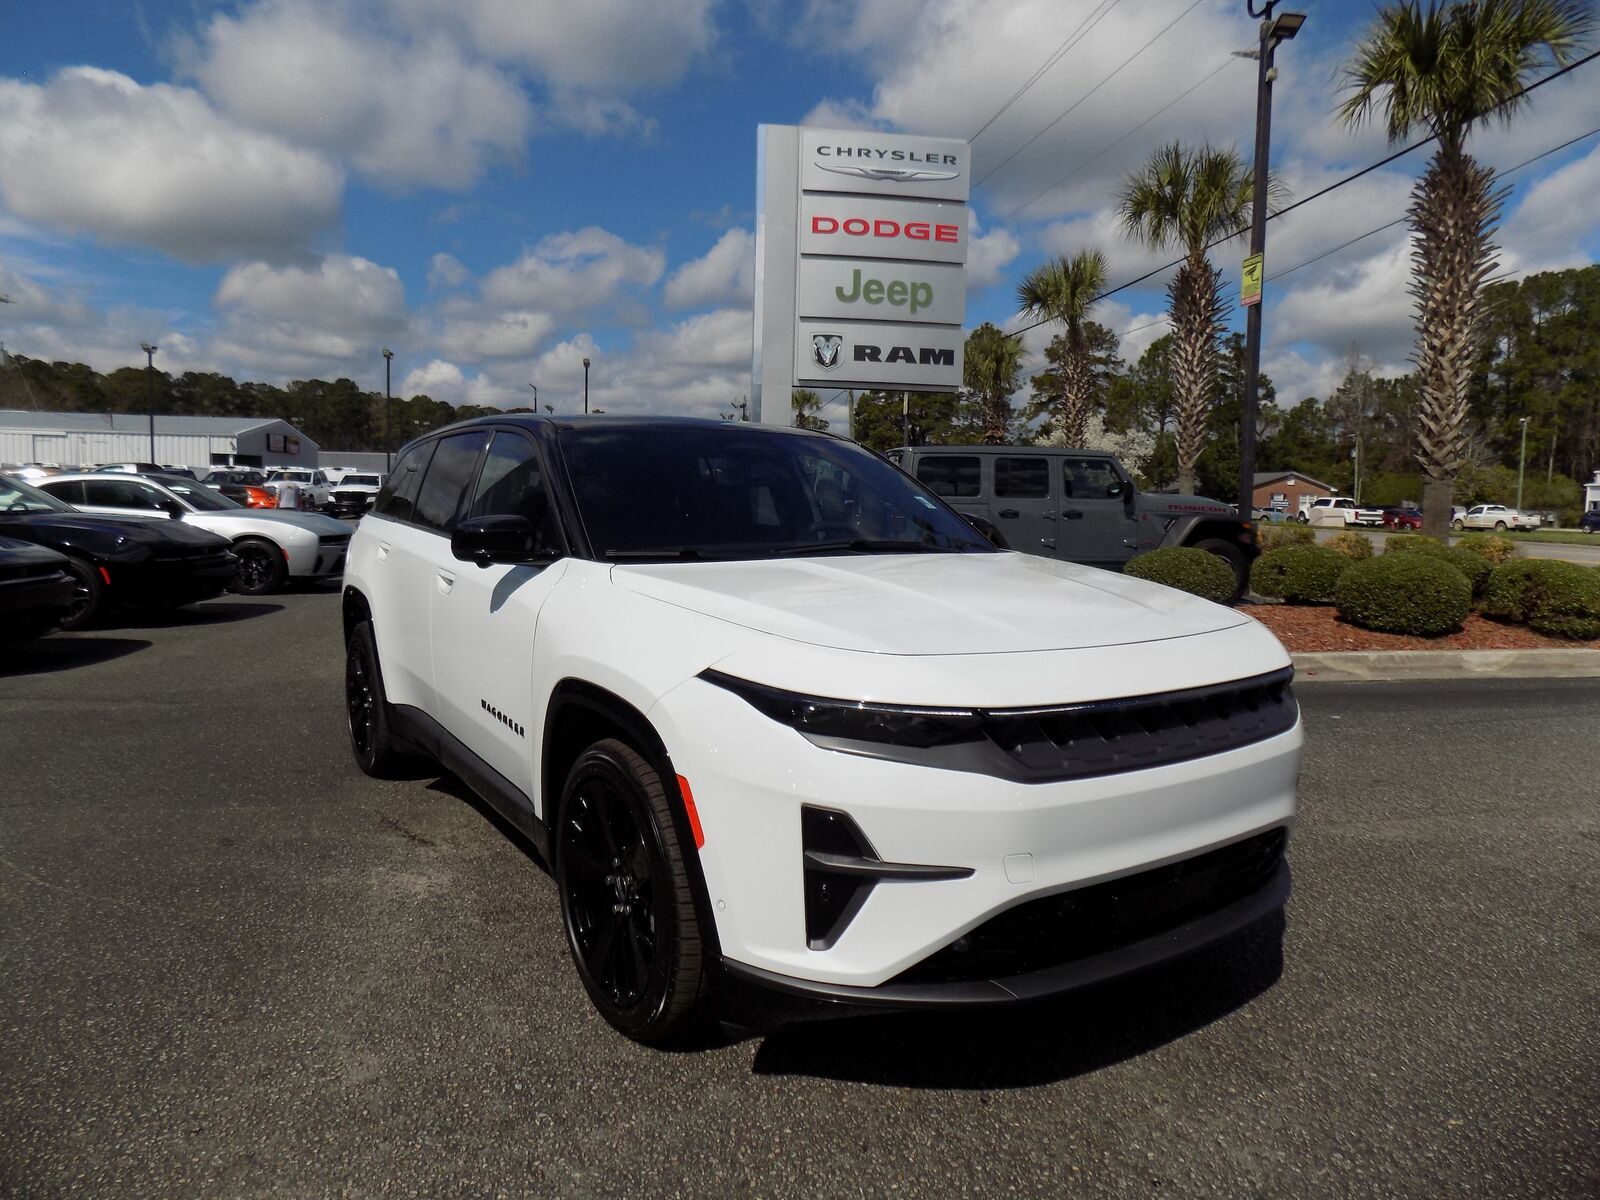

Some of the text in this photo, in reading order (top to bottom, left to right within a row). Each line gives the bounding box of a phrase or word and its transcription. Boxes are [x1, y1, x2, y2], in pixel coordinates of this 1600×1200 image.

[816, 145, 958, 165] CHRYSLER
[811, 216, 959, 243] DODGE
[835, 269, 934, 314] Jeep
[853, 344, 955, 366] RAM
[1168, 504, 1227, 513] RUBICON
[480, 698, 525, 739] WAGONEER
